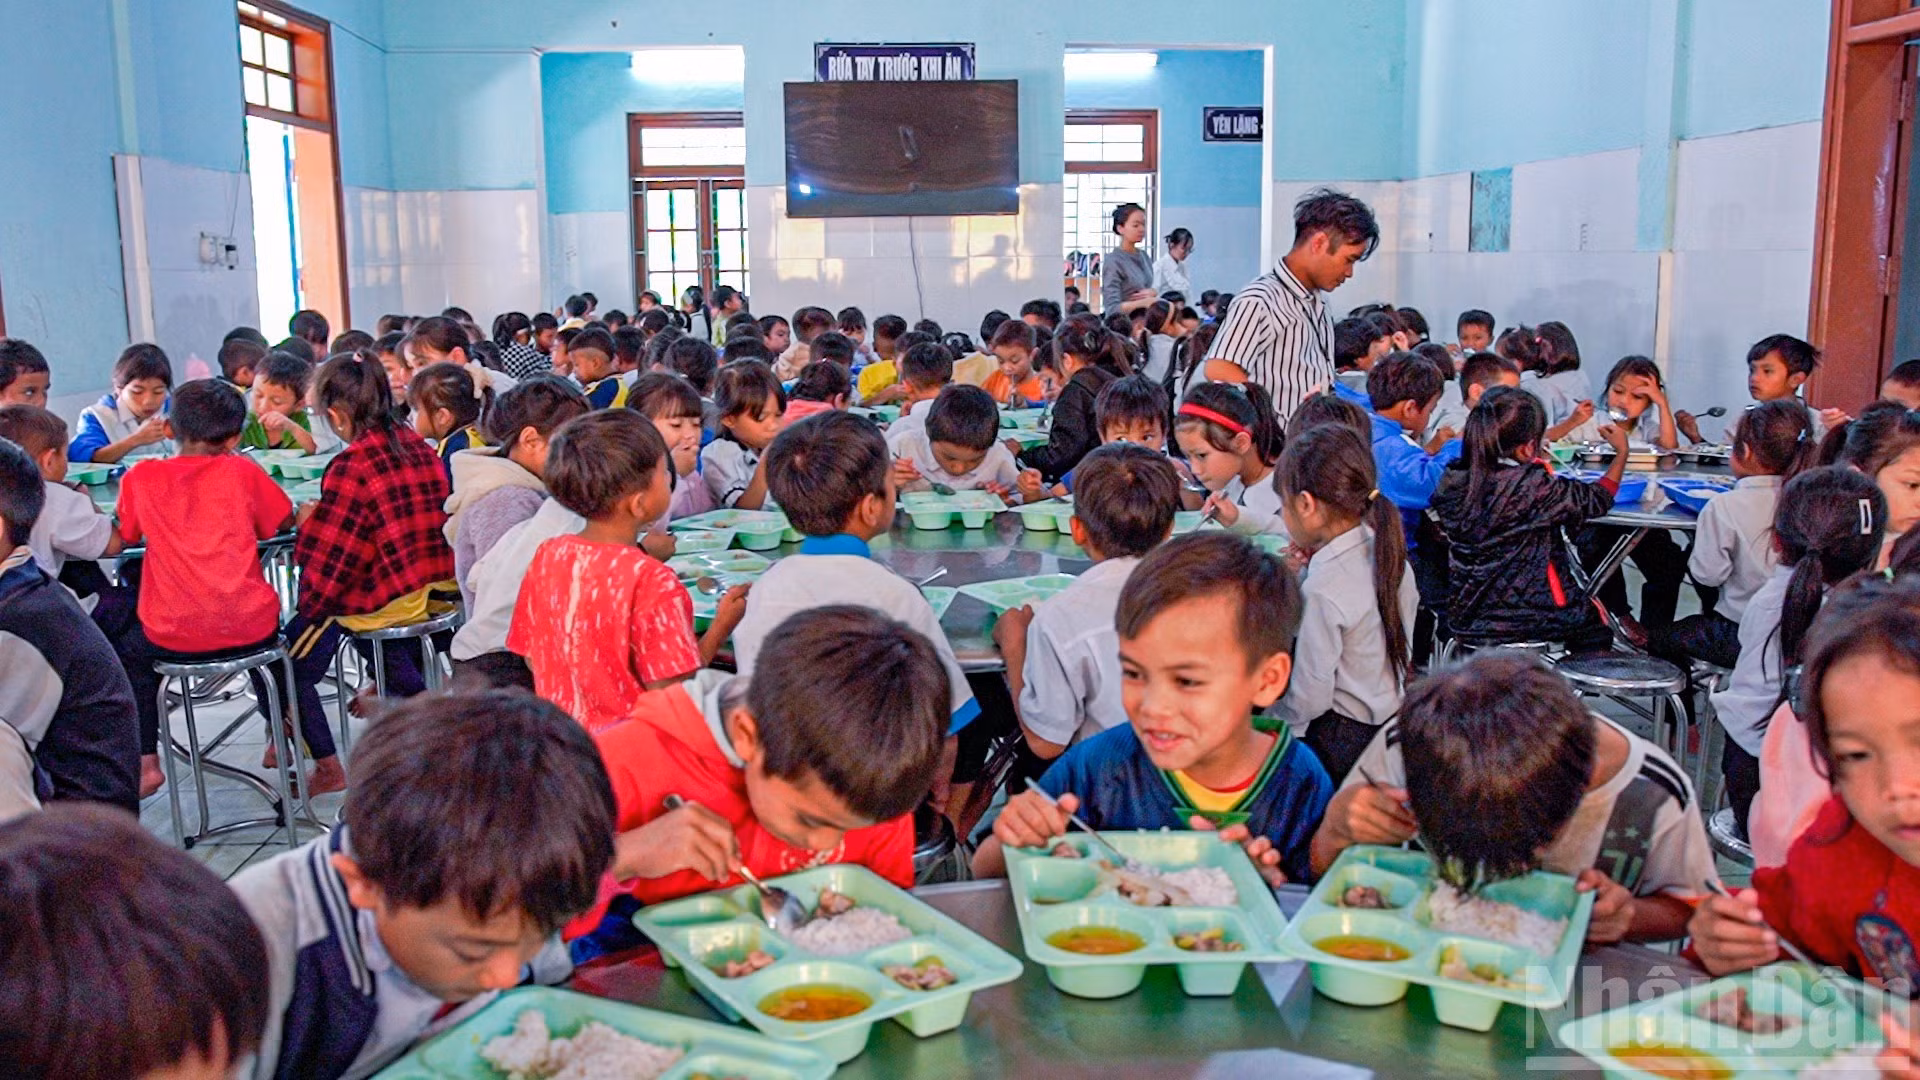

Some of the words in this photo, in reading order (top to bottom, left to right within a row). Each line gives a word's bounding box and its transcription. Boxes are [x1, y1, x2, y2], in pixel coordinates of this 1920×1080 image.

[828, 50, 853, 81] RỬA
[855, 56, 876, 81] TAY
[877, 52, 918, 81] TRƯỚC
[921, 56, 942, 81] KHI
[944, 52, 961, 81] ĂN
[1212, 114, 1231, 134] YÊN
[1233, 114, 1259, 137] LẶNG
